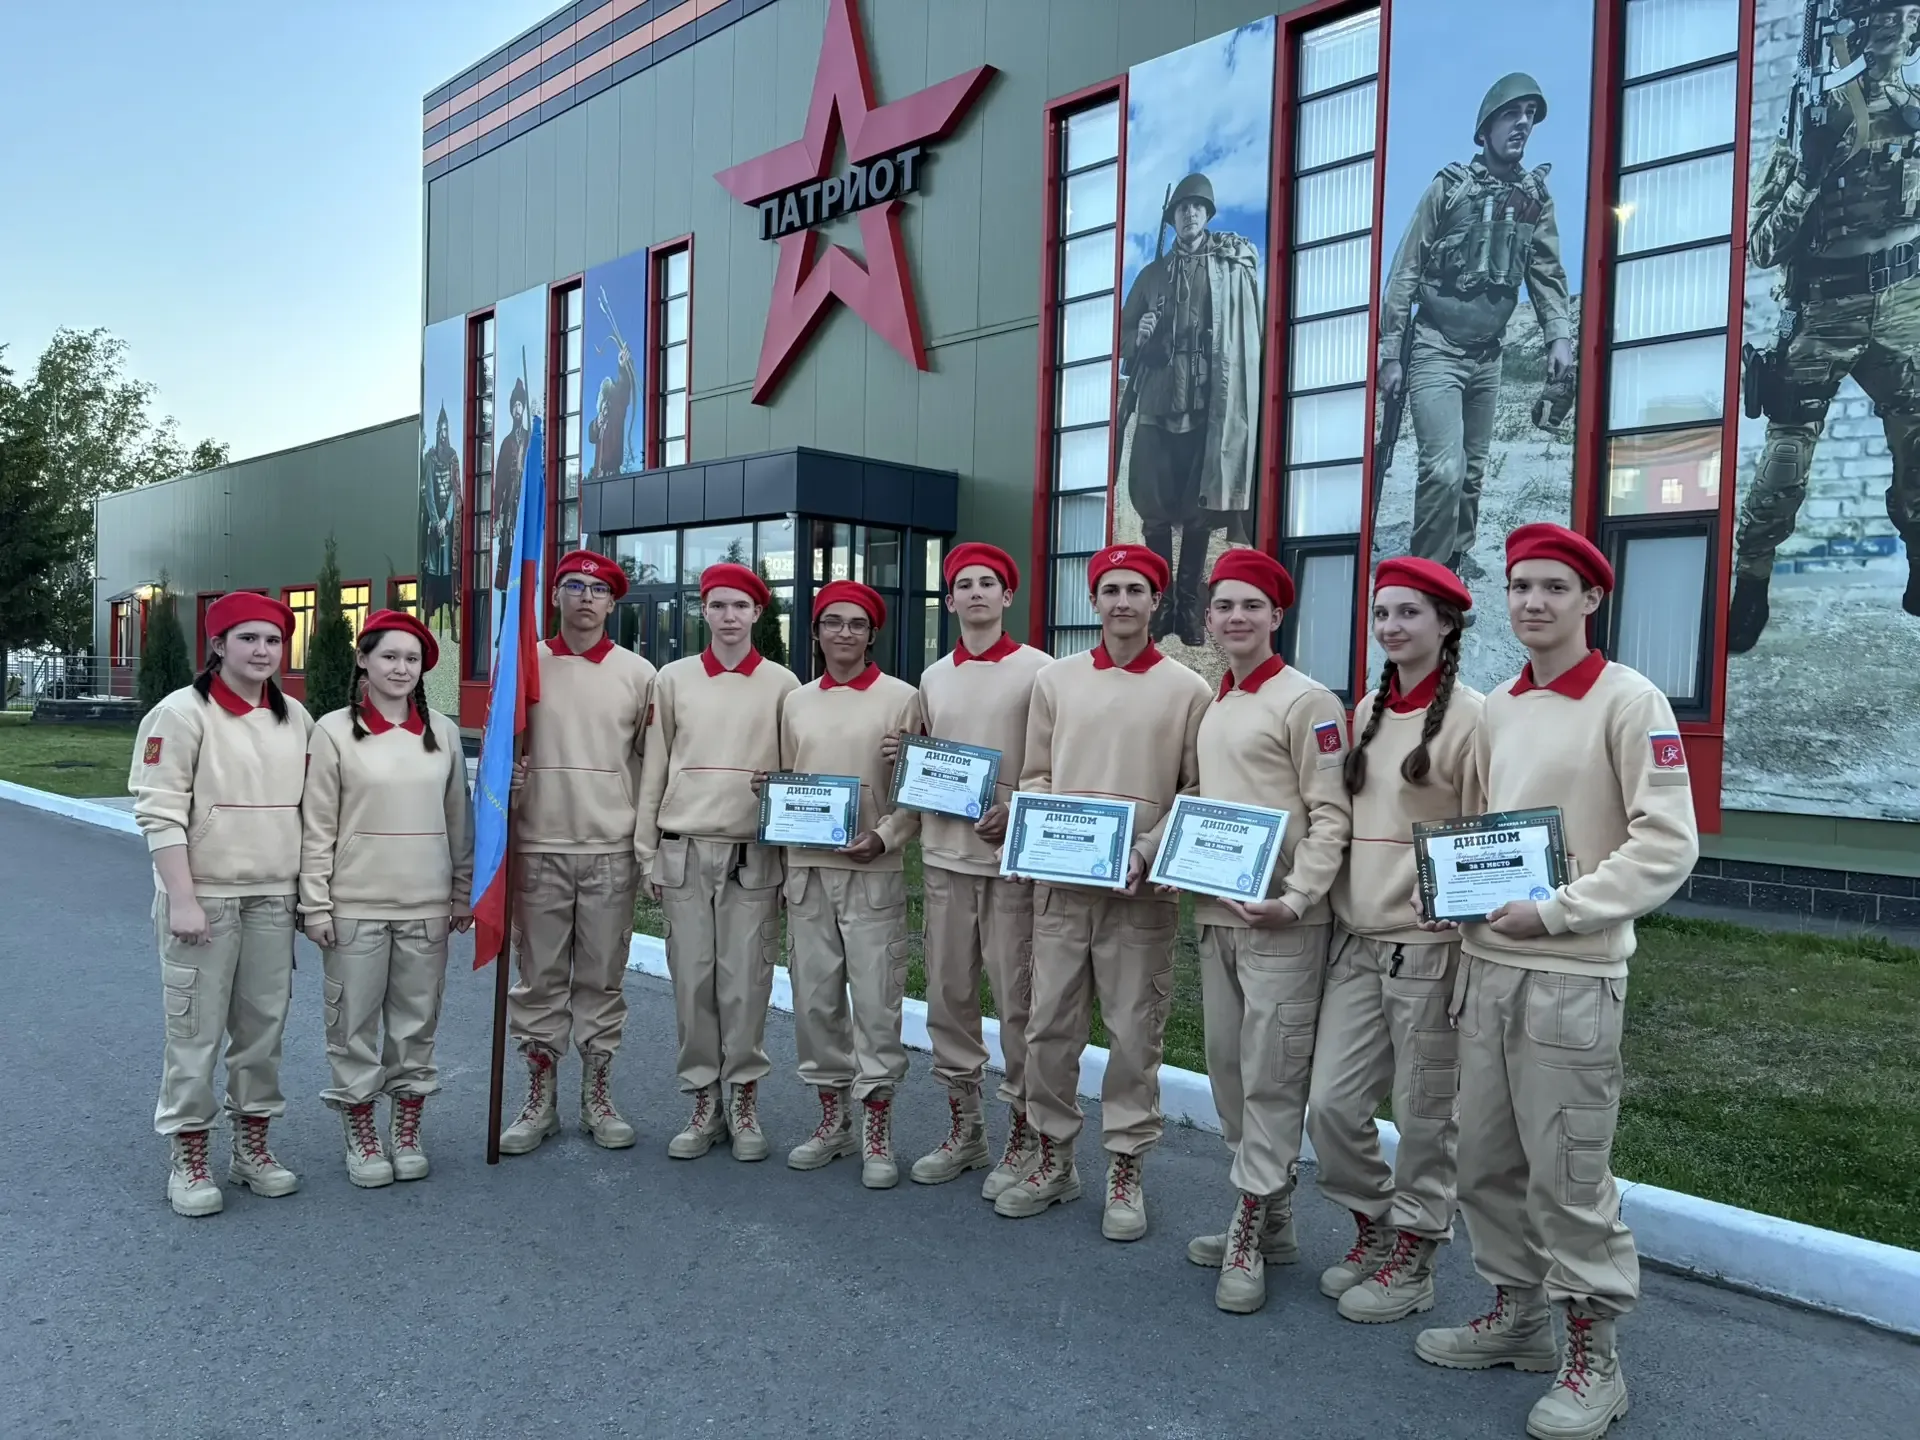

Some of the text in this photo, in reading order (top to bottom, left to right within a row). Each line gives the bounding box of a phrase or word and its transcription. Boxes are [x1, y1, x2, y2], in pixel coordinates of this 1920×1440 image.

[759, 146, 921, 239] ПАТРИОТ
[924, 751, 972, 766] ДИПЛОМ
[786, 787, 833, 796] ДИПЛОМ
[1045, 813, 1098, 825] ДИПЛОМ
[1200, 819, 1250, 835] ДИПЛОМ
[1453, 831, 1521, 850] ДИПЛОМ
